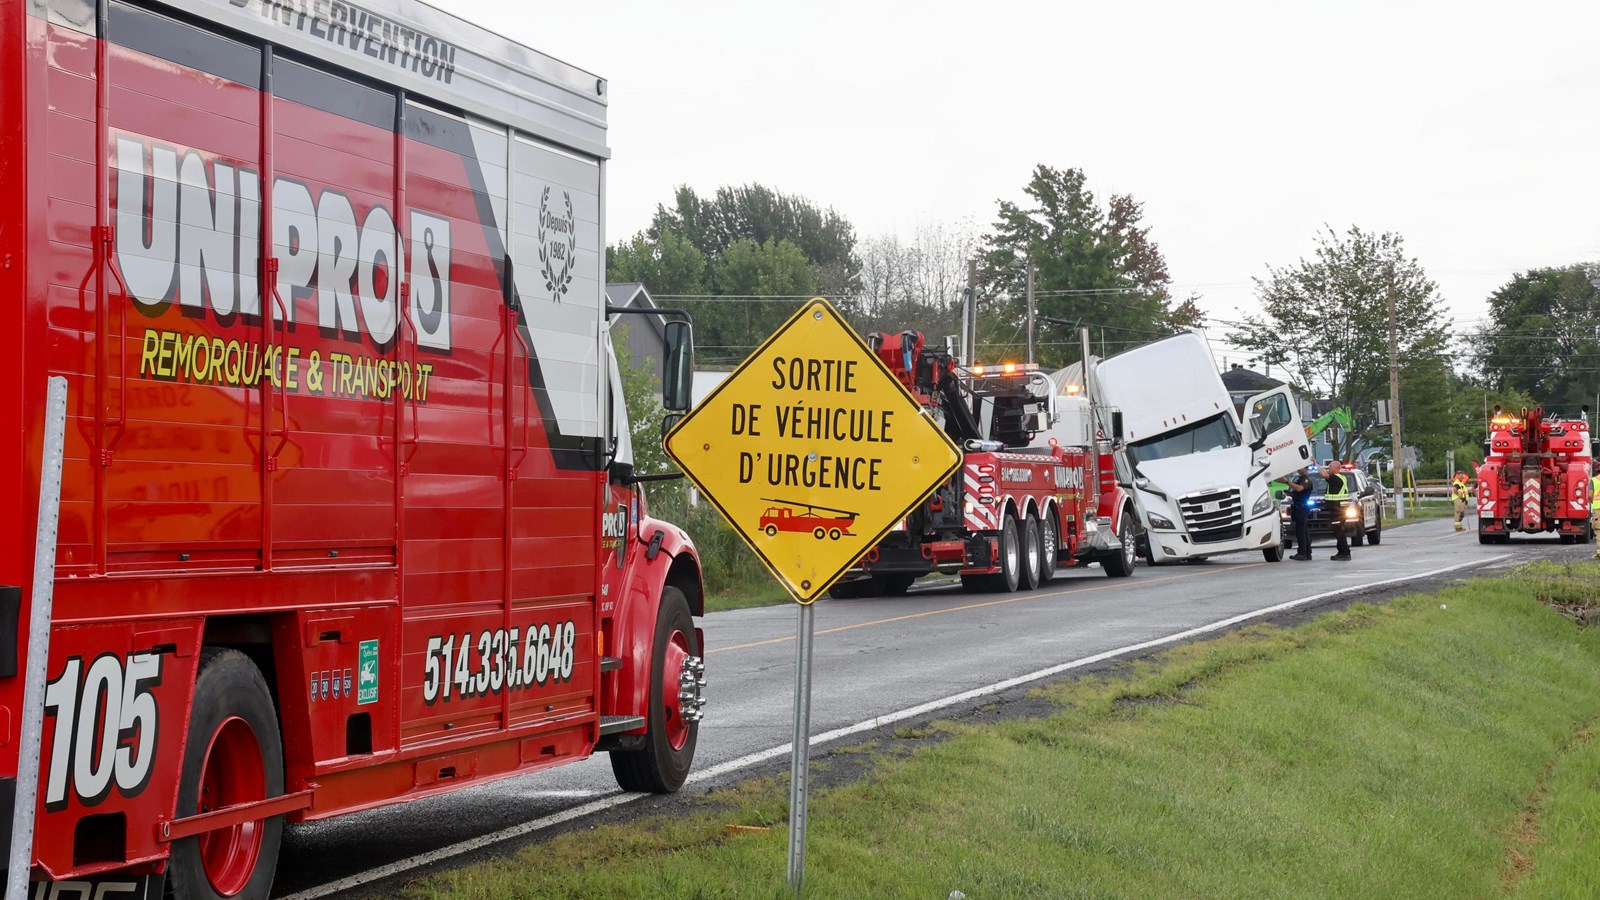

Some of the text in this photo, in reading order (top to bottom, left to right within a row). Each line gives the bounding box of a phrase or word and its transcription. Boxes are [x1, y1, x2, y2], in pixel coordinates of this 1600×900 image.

[113, 134, 404, 347] UNIPRO
[546, 211, 568, 234] Depuis
[549, 241, 566, 261] 1982
[139, 328, 433, 402] REMORQUAGE & TRANSPORT
[771, 356, 858, 393] SORTIE
[731, 401, 895, 443] DE VÉHICULE
[1272, 439, 1295, 453] ARMOUR
[739, 452, 883, 491] D'URGENCE
[422, 619, 576, 705] 514.335.6648
[44, 652, 162, 807] 105
